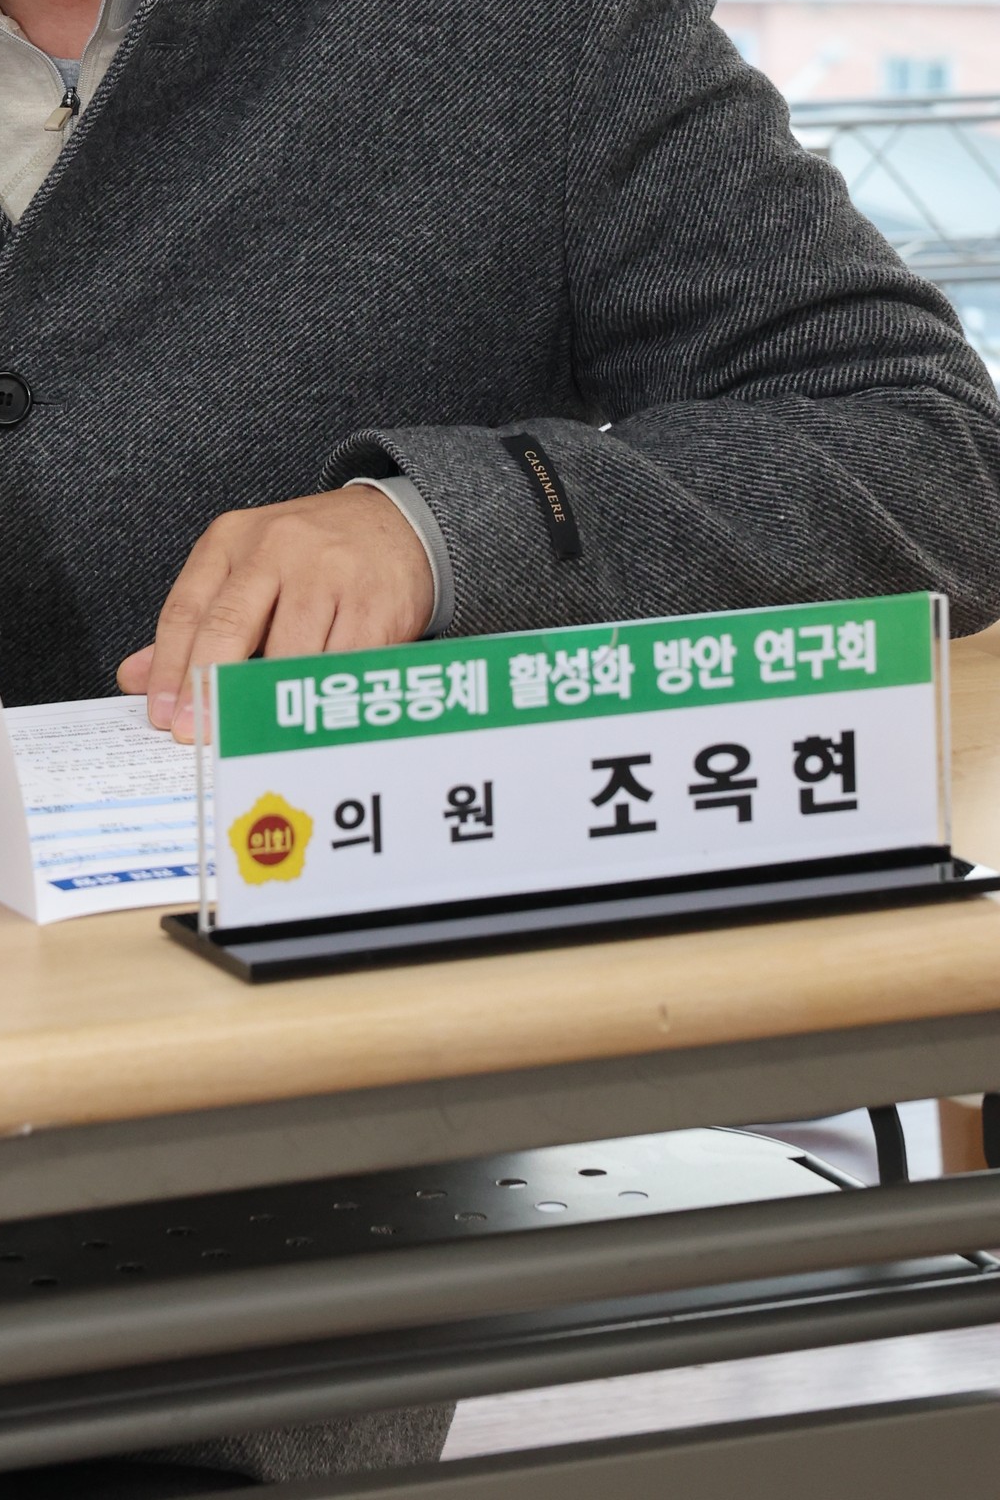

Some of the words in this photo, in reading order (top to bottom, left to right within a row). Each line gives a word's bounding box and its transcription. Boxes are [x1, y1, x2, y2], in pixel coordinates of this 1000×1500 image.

[524, 450, 566, 523] CASHMERE
[276, 659, 488, 734] 마을공동체
[509, 644, 634, 709] 활성화
[653, 633, 736, 693] 방안
[755, 619, 878, 683] 연구회
